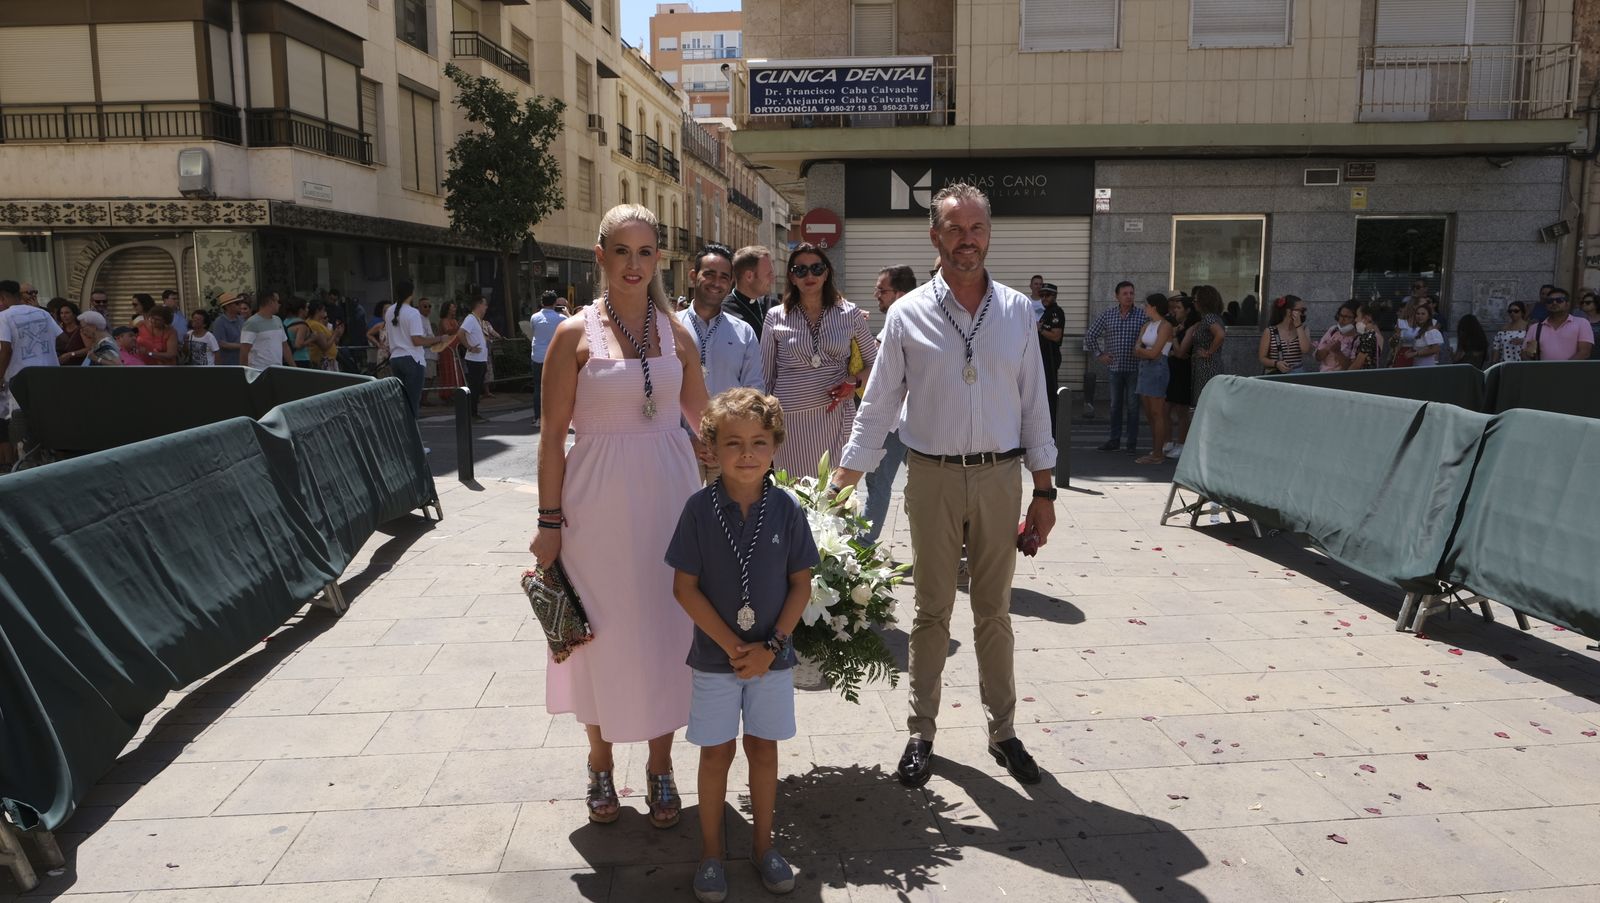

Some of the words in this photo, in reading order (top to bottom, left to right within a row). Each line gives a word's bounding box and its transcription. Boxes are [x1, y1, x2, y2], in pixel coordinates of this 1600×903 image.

[755, 69, 837, 84] CLINICA
[845, 67, 927, 82] DENTAL
[765, 88, 782, 96] Dr.
[786, 86, 835, 95] Francisco
[841, 86, 868, 94] Caba
[871, 86, 918, 94] Calvache
[765, 97, 781, 105] Dr.
[786, 97, 835, 106] Alejandro
[841, 96, 868, 104] Caba
[871, 95, 918, 103] Calvache
[944, 174, 995, 188] MAÑAS
[1002, 175, 1047, 187] CANO
